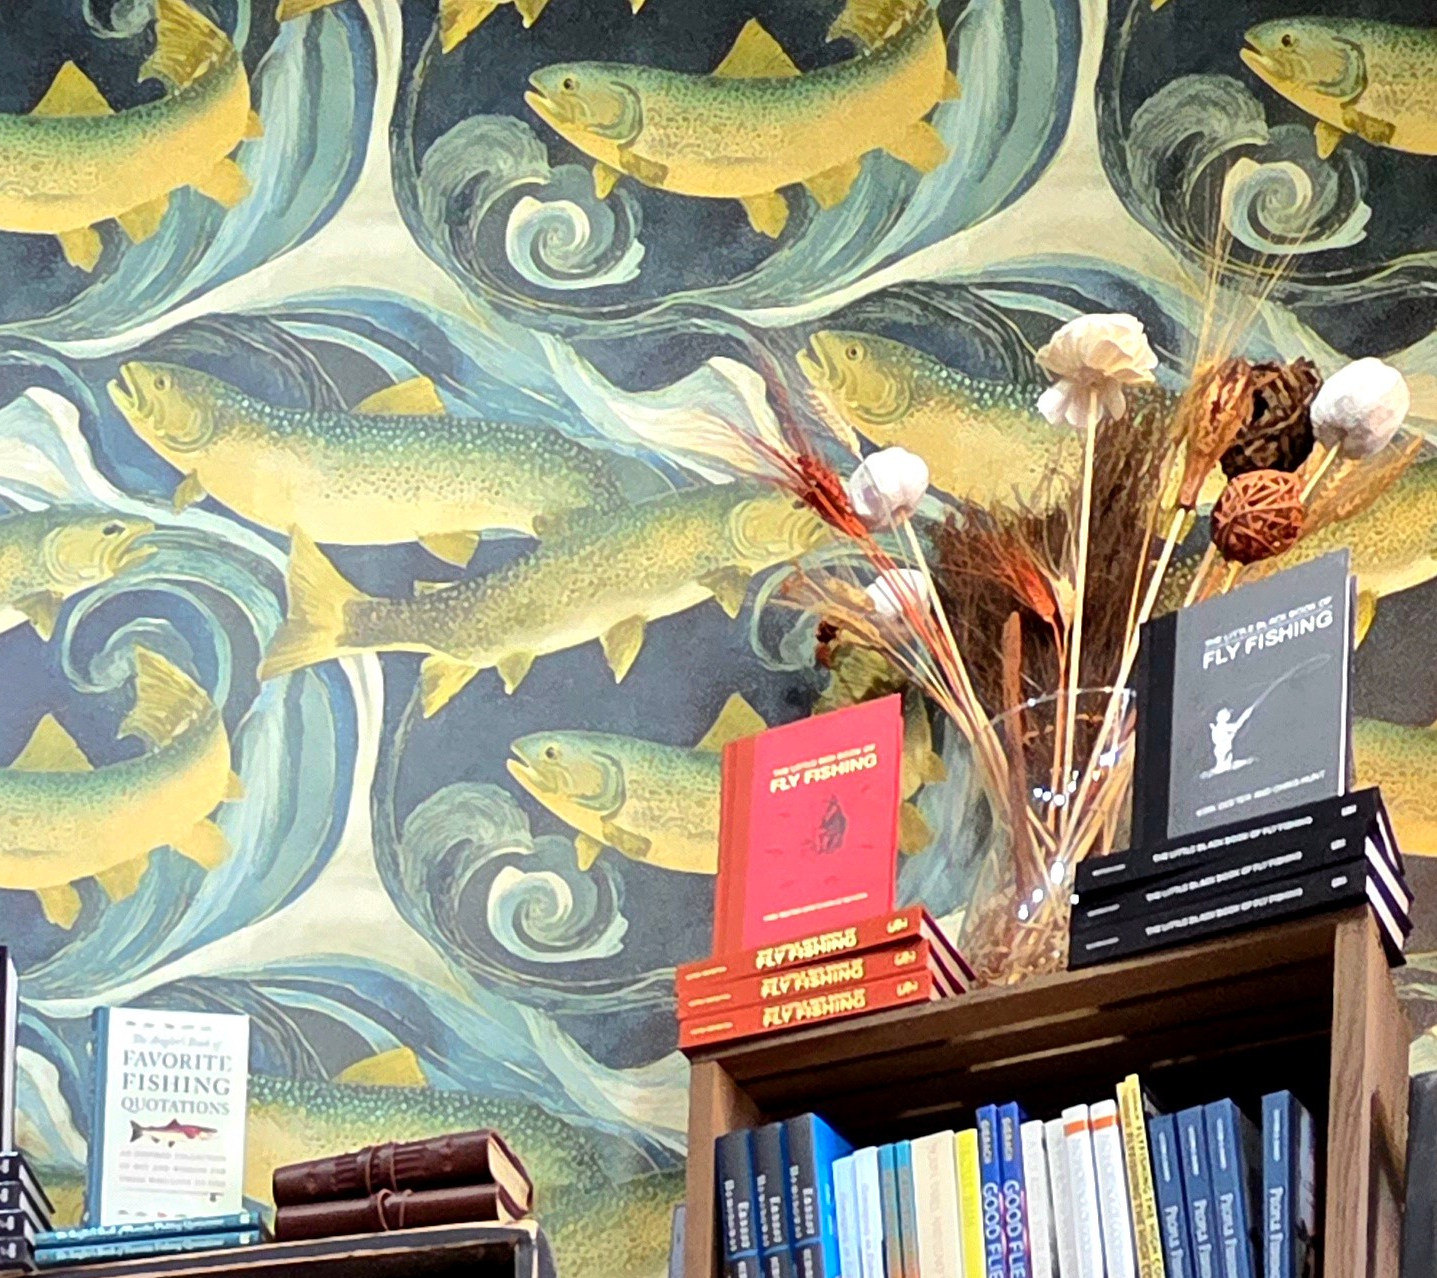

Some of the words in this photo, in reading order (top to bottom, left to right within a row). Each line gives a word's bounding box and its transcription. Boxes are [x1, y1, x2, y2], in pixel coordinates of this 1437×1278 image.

[1202, 642, 1240, 670] FLY
[1245, 610, 1333, 655] FISHING
[770, 773, 800, 793] FLY
[804, 753, 878, 784] FISHING
[123, 1050, 232, 1072] FAVORITE
[123, 1072, 231, 1095] FISHING
[121, 1097, 231, 1115] QUOTATIONS
[983, 1182, 1001, 1240] GOOD
[1003, 1179, 1022, 1237] GOOD
